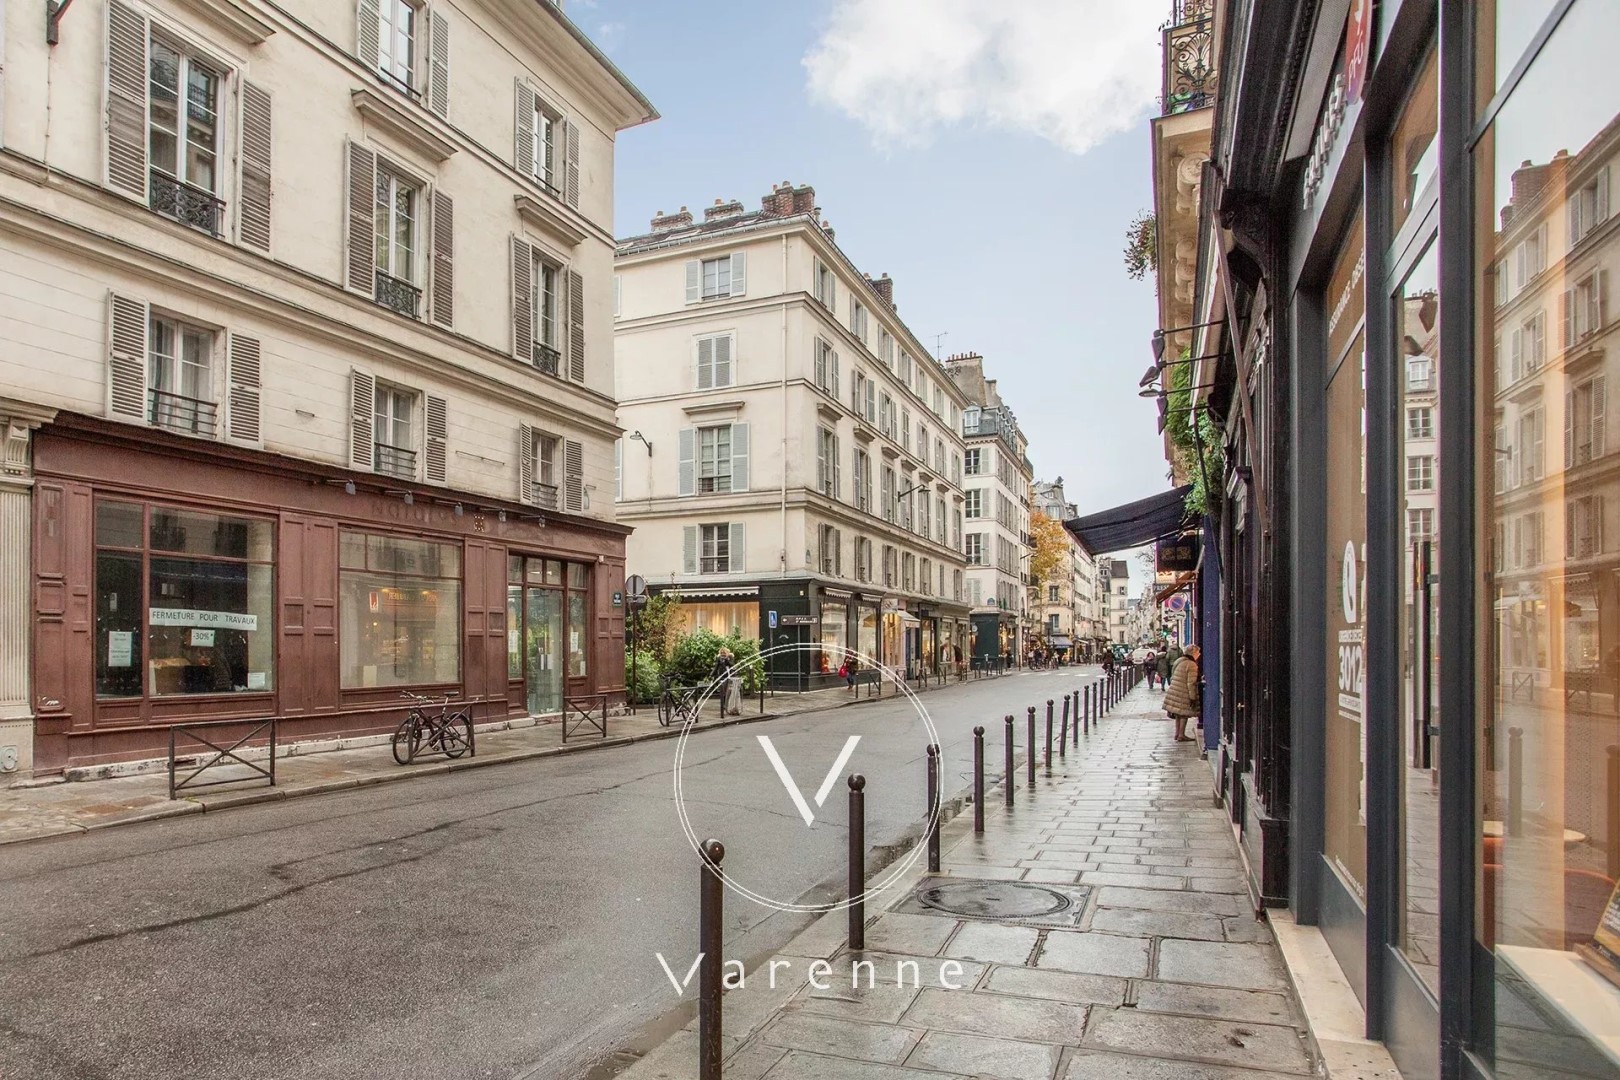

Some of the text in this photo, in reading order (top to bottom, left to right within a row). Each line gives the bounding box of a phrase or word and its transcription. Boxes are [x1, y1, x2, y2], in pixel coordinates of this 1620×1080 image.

[152, 610, 255, 625] FERMETURE POUR TRAVAUX
[1338, 645, 1363, 693] 3012
